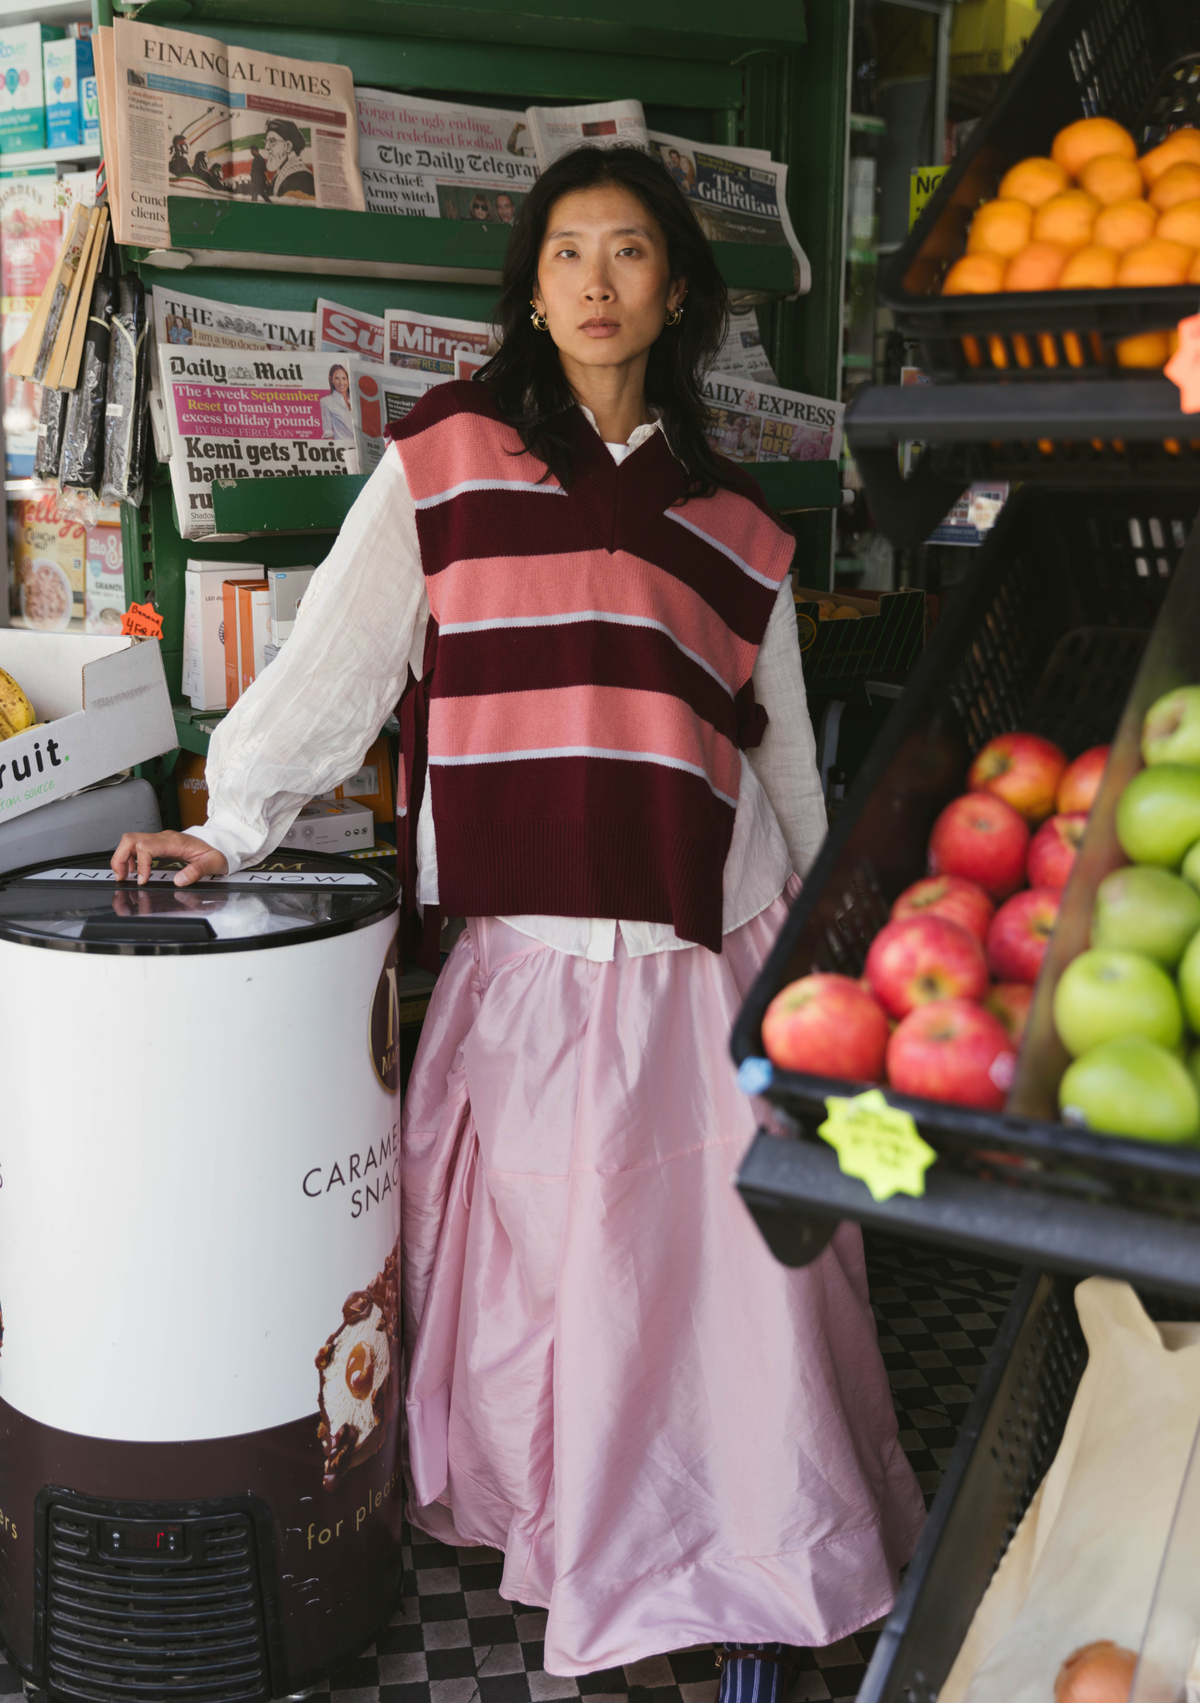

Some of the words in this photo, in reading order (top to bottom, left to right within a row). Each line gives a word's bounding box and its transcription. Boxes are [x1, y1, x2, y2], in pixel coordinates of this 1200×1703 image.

[143, 39, 261, 83] FINANCIAL
[265, 66, 331, 97] TIMES
[357, 102, 395, 122] Forget
[399, 109, 419, 125] the
[421, 114, 446, 130] ugly
[449, 117, 494, 136] ending,
[360, 120, 394, 139] Messi
[397, 128, 455, 147] redefined
[457, 133, 503, 151] football
[377, 145, 413, 168] The
[414, 149, 465, 174] Daily
[362, 170, 388, 184] SAS
[390, 172, 424, 188] chief:
[712, 173, 745, 196] The
[365, 186, 401, 203] Army
[402, 188, 435, 204] witch
[697, 181, 779, 217] Guardian
[131, 206, 166, 222] clients
[366, 200, 404, 215] hunts
[725, 221, 747, 232] Google
[747, 225, 766, 234] Cloud
[165, 300, 214, 328] THE
[193, 329, 197, 338] I
[198, 332, 213, 343] am
[214, 336, 220, 344] a
[221, 336, 237, 349] top
[237, 339, 266, 352] doctor
[390, 322, 398, 341] DAILY
[397, 323, 487, 357] Mirror
[169, 356, 228, 385] Daily
[253, 361, 304, 382] Mail
[417, 358, 437, 370] FREE
[439, 361, 455, 374] BIN
[175, 385, 202, 397] The
[203, 388, 249, 399] 4-week
[250, 390, 320, 402] September
[387, 397, 410, 406] Snapchat
[187, 399, 222, 411] Reset
[223, 403, 236, 412] to
[239, 402, 282, 413] banish
[283, 404, 313, 416] your
[757, 393, 836, 427] EXPRESS
[182, 413, 222, 424] excess
[224, 414, 272, 427] holiday
[273, 416, 320, 428] pounds
[764, 420, 794, 439] £10
[195, 425, 208, 434] BY
[210, 426, 238, 436] ROSE
[239, 428, 294, 438] FERGUSON
[184, 437, 245, 459] Kemi
[246, 443, 291, 465] gets
[293, 442, 356, 463] Torie
[761, 436, 793, 454] OFF
[187, 461, 250, 483] battle
[126, 617, 134, 632] 4
[131, 604, 160, 626] Banana
[24, 780, 55, 801] source
[249, 874, 345, 882] NOW
[302, 1121, 399, 1198] CARAME
[350, 1157, 399, 1219] SNAC
[306, 1518, 344, 1551] for
